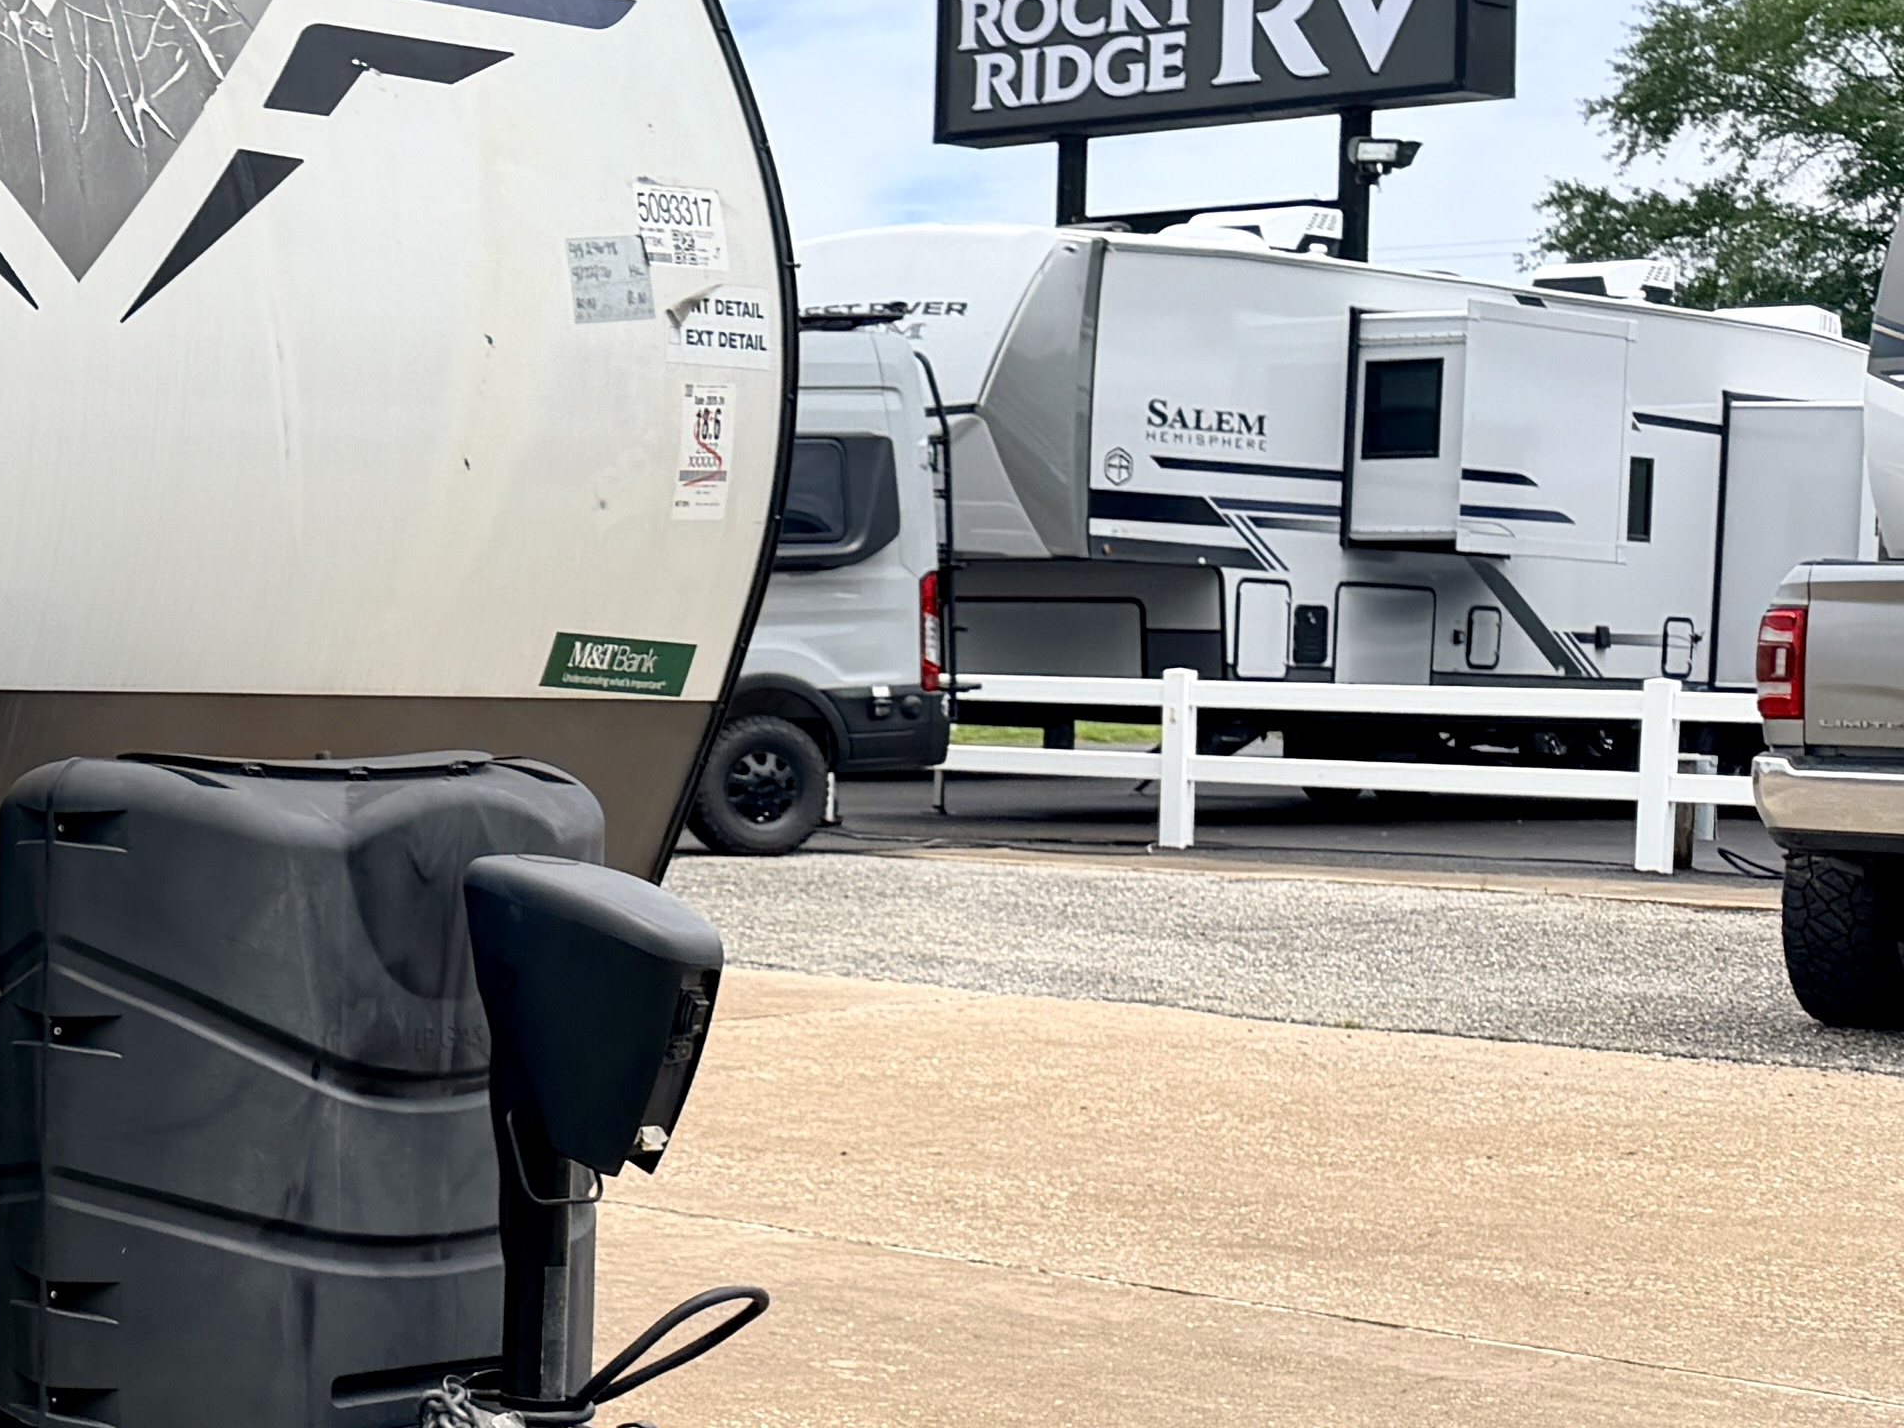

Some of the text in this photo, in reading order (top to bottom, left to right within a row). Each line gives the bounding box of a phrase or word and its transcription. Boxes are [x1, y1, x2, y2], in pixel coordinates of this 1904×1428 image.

[971, 29, 1188, 111] RIDGE
[636, 192, 712, 228] 5093317
[691, 298, 765, 320] NT DETAIL
[869, 300, 969, 316] RVER
[686, 329, 768, 352] EXT DETAIL
[1145, 429, 1268, 453] HEMISPHERE
